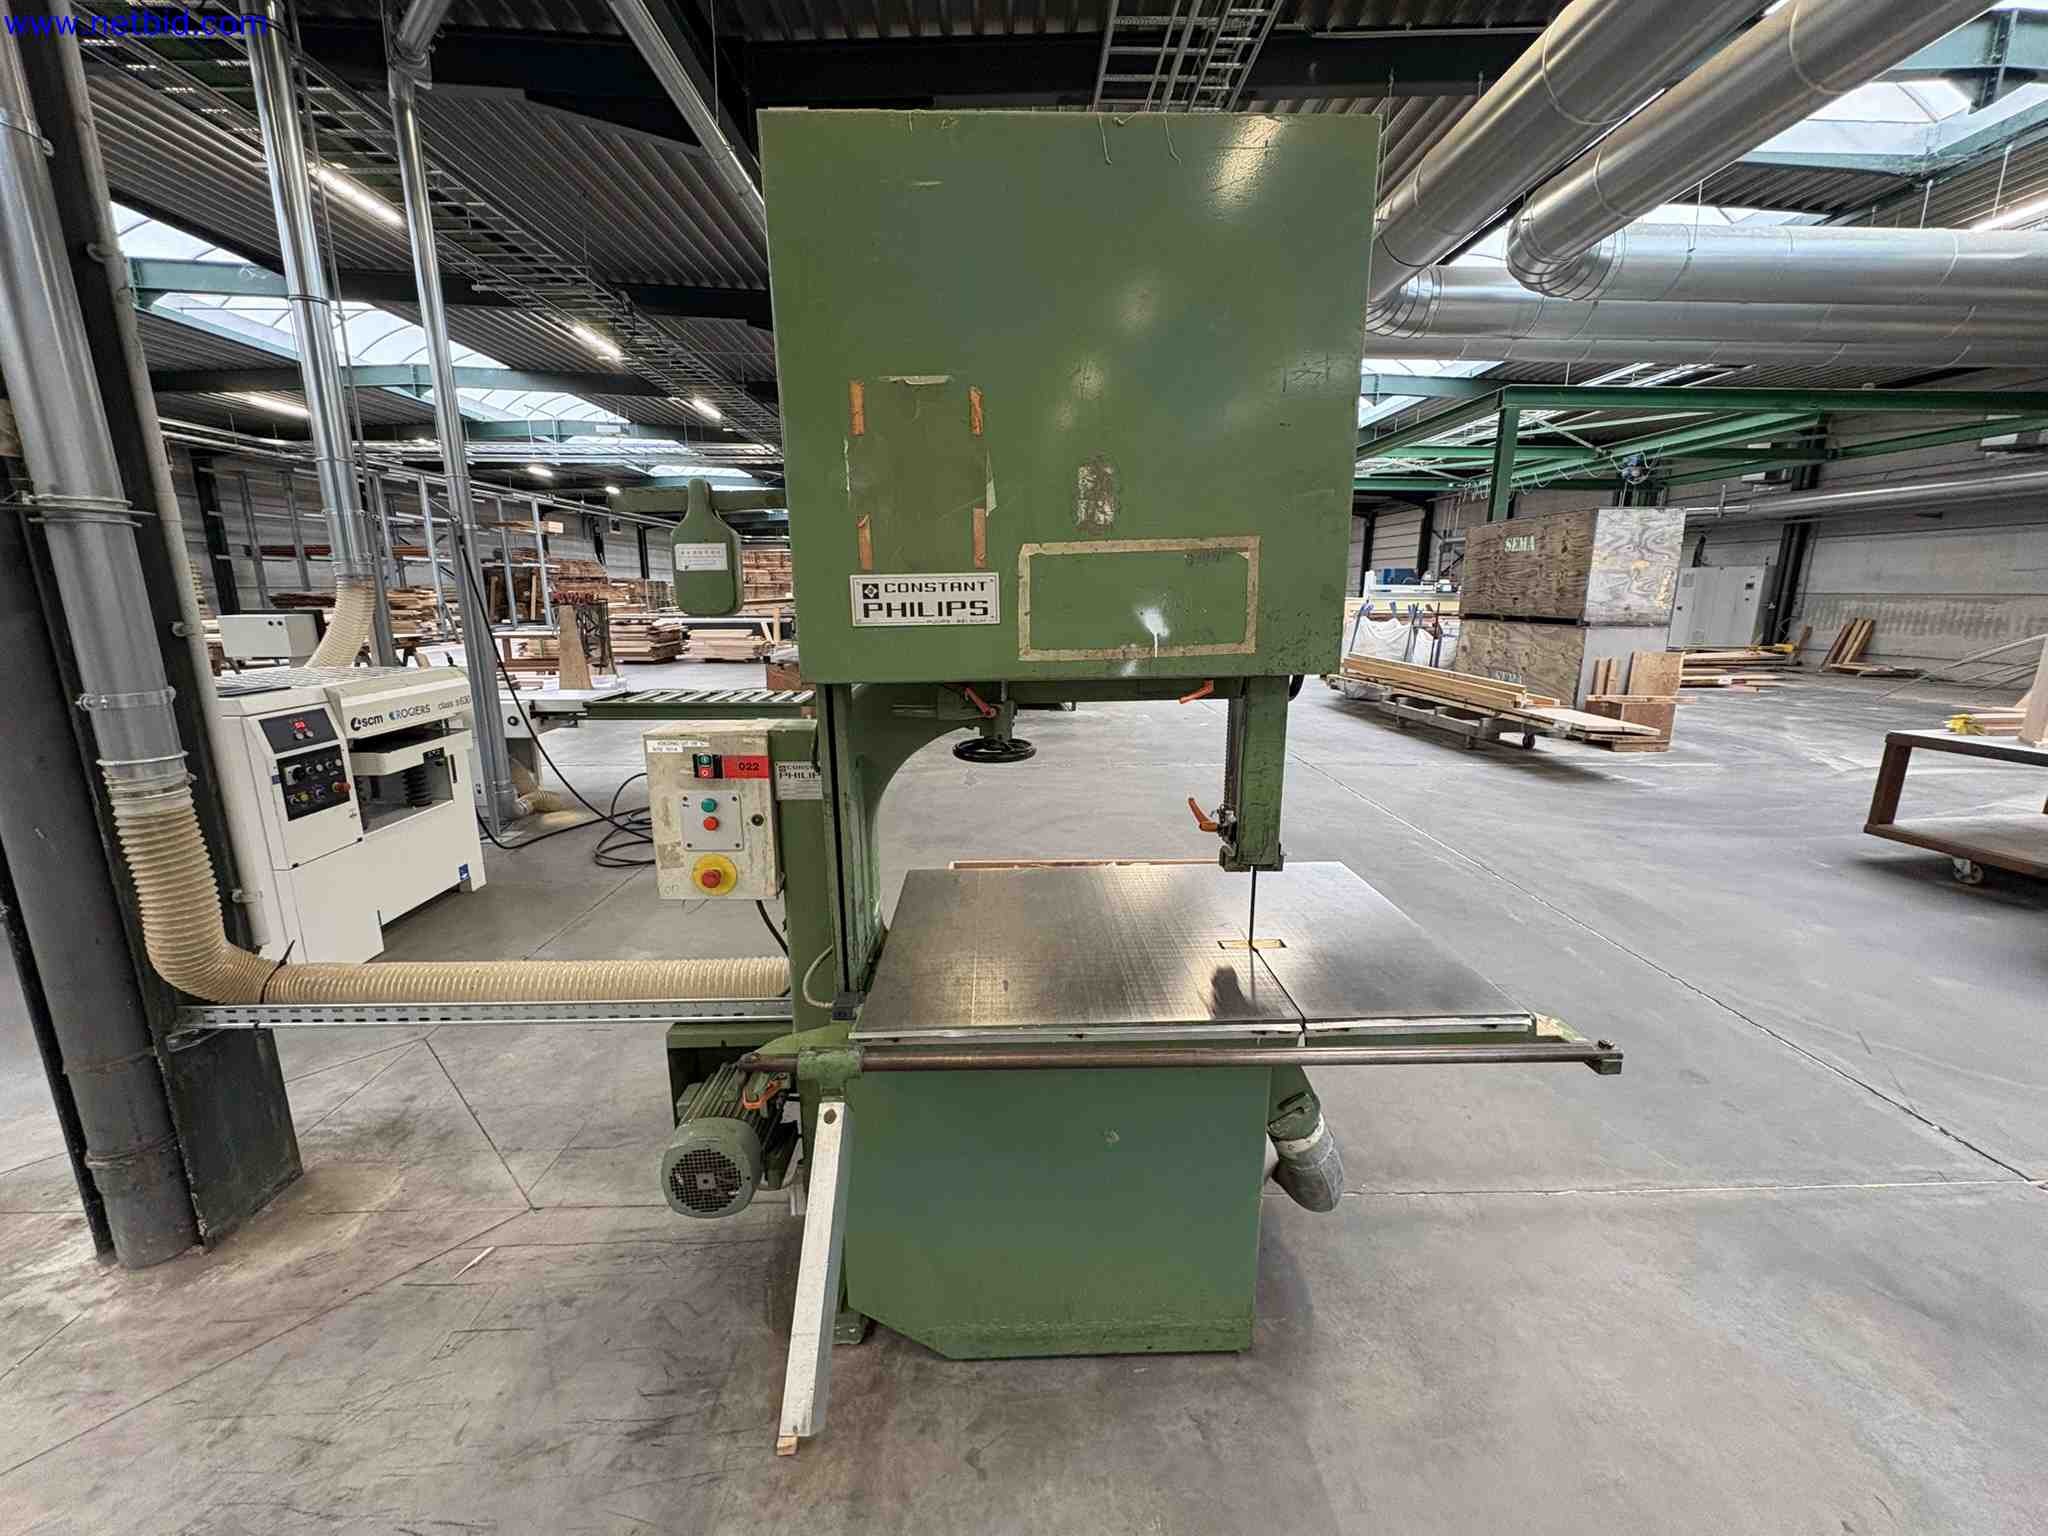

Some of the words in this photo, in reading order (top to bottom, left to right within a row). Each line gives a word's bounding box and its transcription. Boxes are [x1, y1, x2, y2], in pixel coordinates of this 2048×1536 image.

[1504, 535, 1535, 552] SEMA
[884, 581, 987, 593] CONSTANT
[863, 600, 989, 618] PHILIPS
[362, 714, 384, 728] scm
[738, 762, 760, 772] 022
